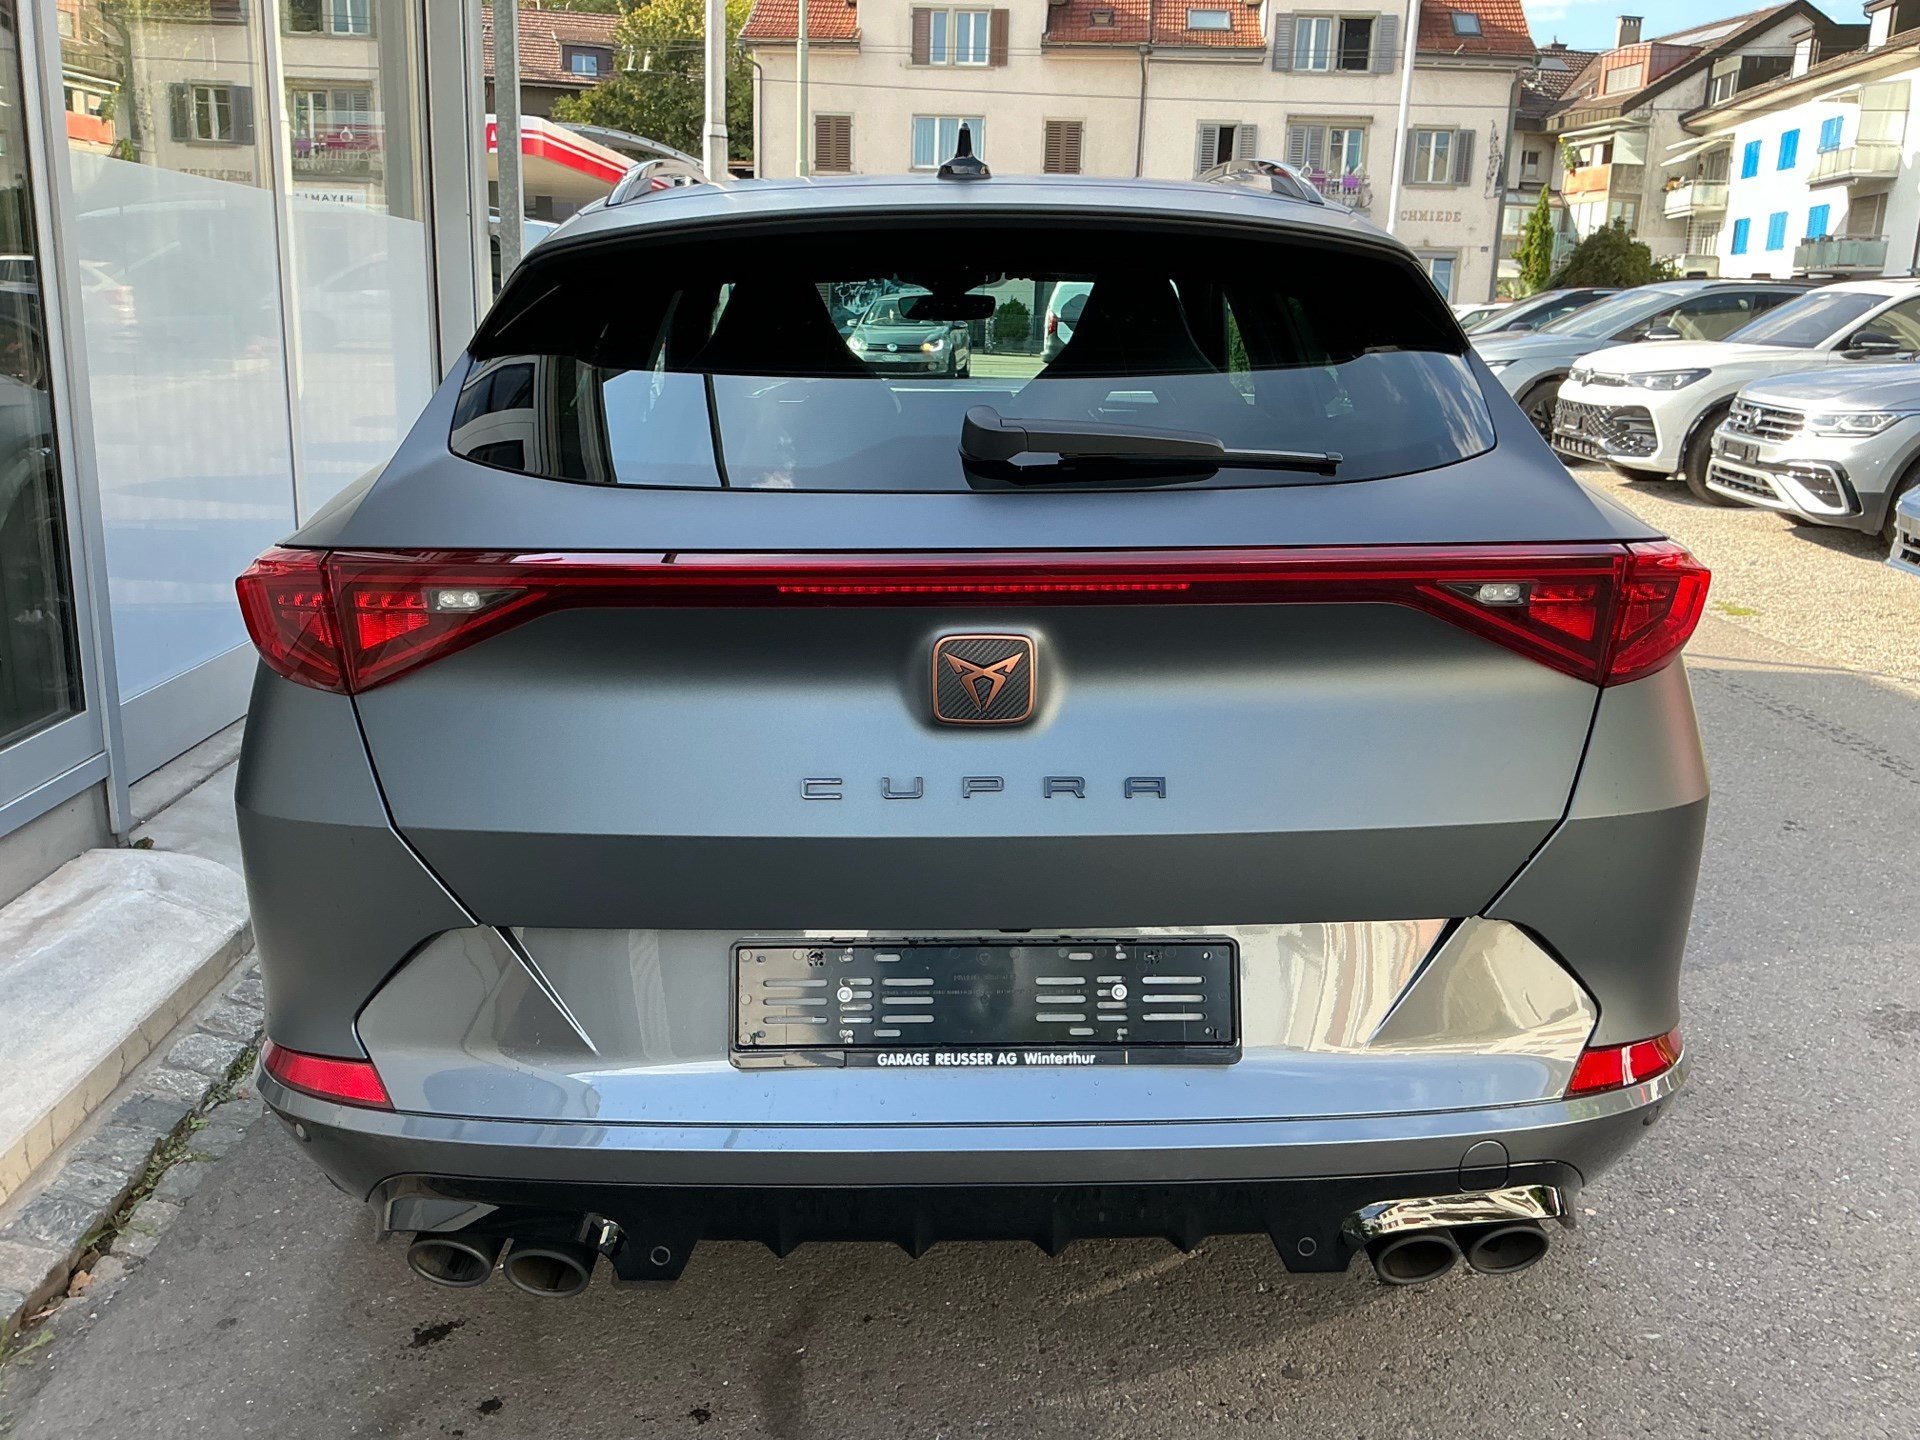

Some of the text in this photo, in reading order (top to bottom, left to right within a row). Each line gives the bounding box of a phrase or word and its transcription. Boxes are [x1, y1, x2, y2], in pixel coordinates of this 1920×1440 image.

[1400, 210, 1462, 223] CHMIEDE
[800, 775, 1167, 801] CUPRA
[877, 1051, 1096, 1066] GARAGE REUSSER AG Winterthur
